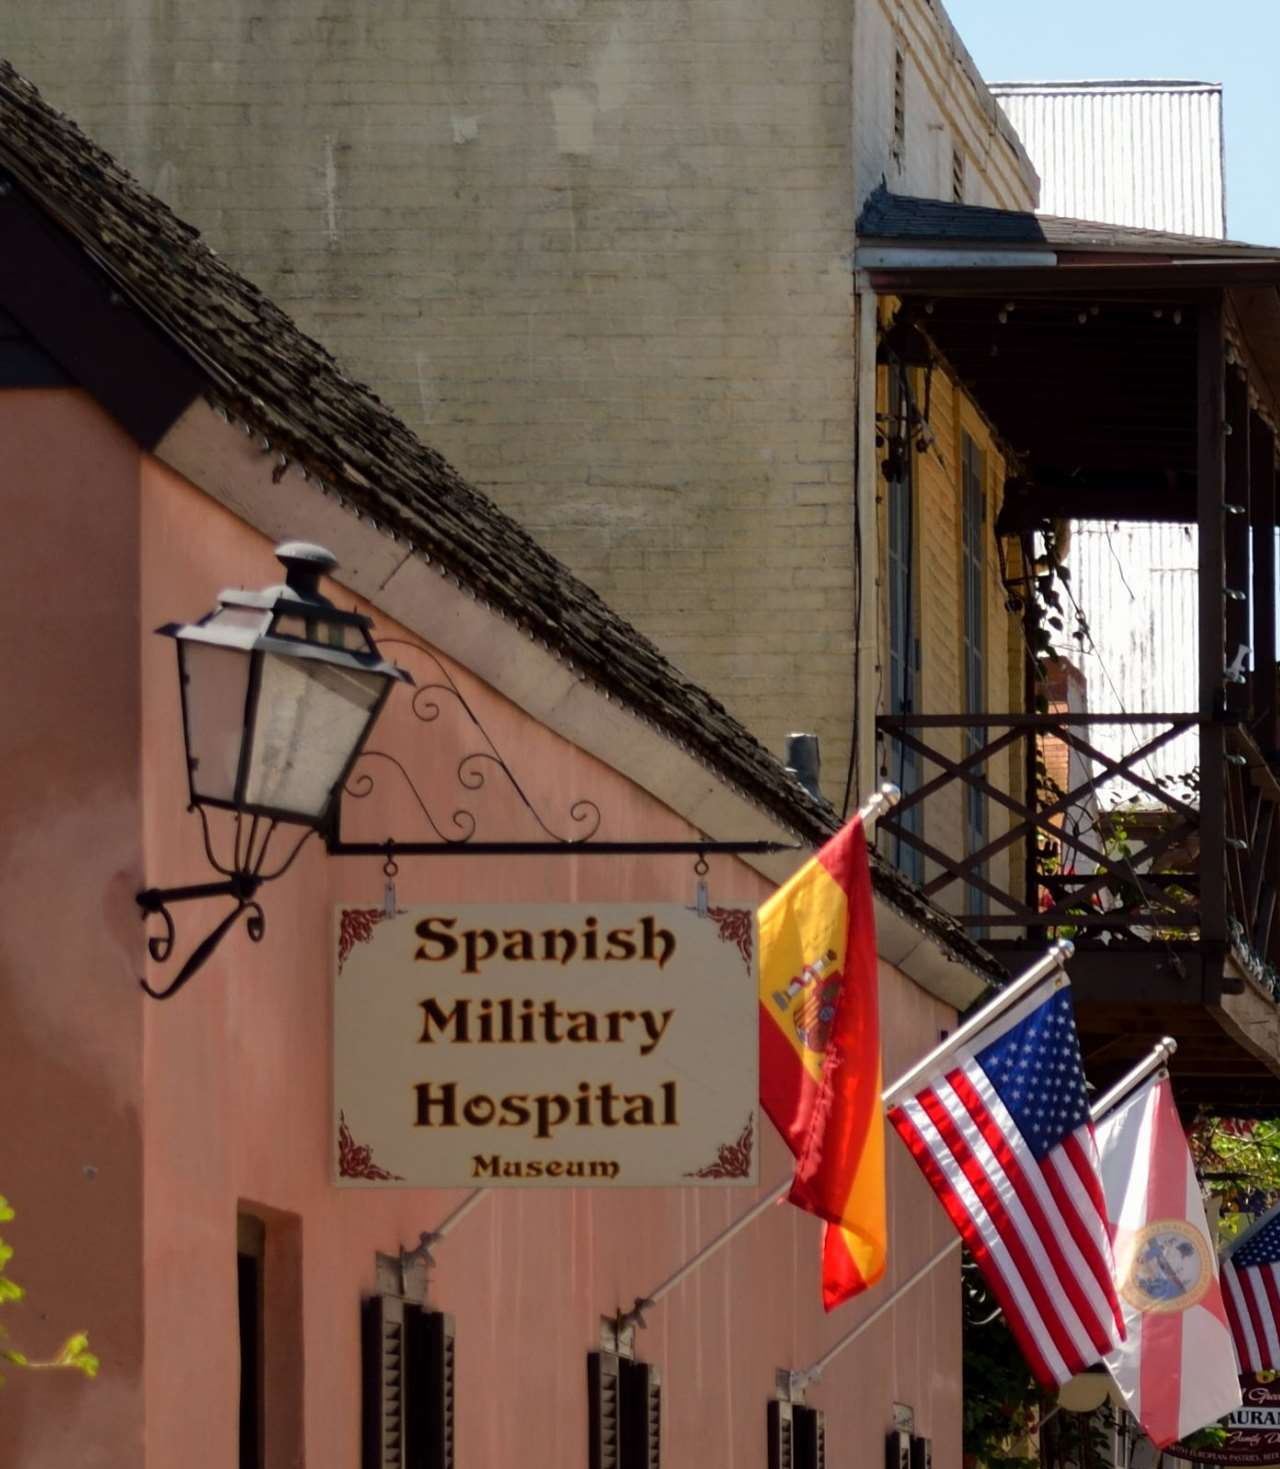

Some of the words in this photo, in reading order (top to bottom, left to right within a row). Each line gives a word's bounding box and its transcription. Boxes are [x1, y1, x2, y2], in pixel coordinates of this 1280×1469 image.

[412, 915, 678, 974] Spanish
[416, 997, 676, 1056] Military
[411, 1081, 680, 1140] Hospital
[471, 1154, 622, 1180] Museum
